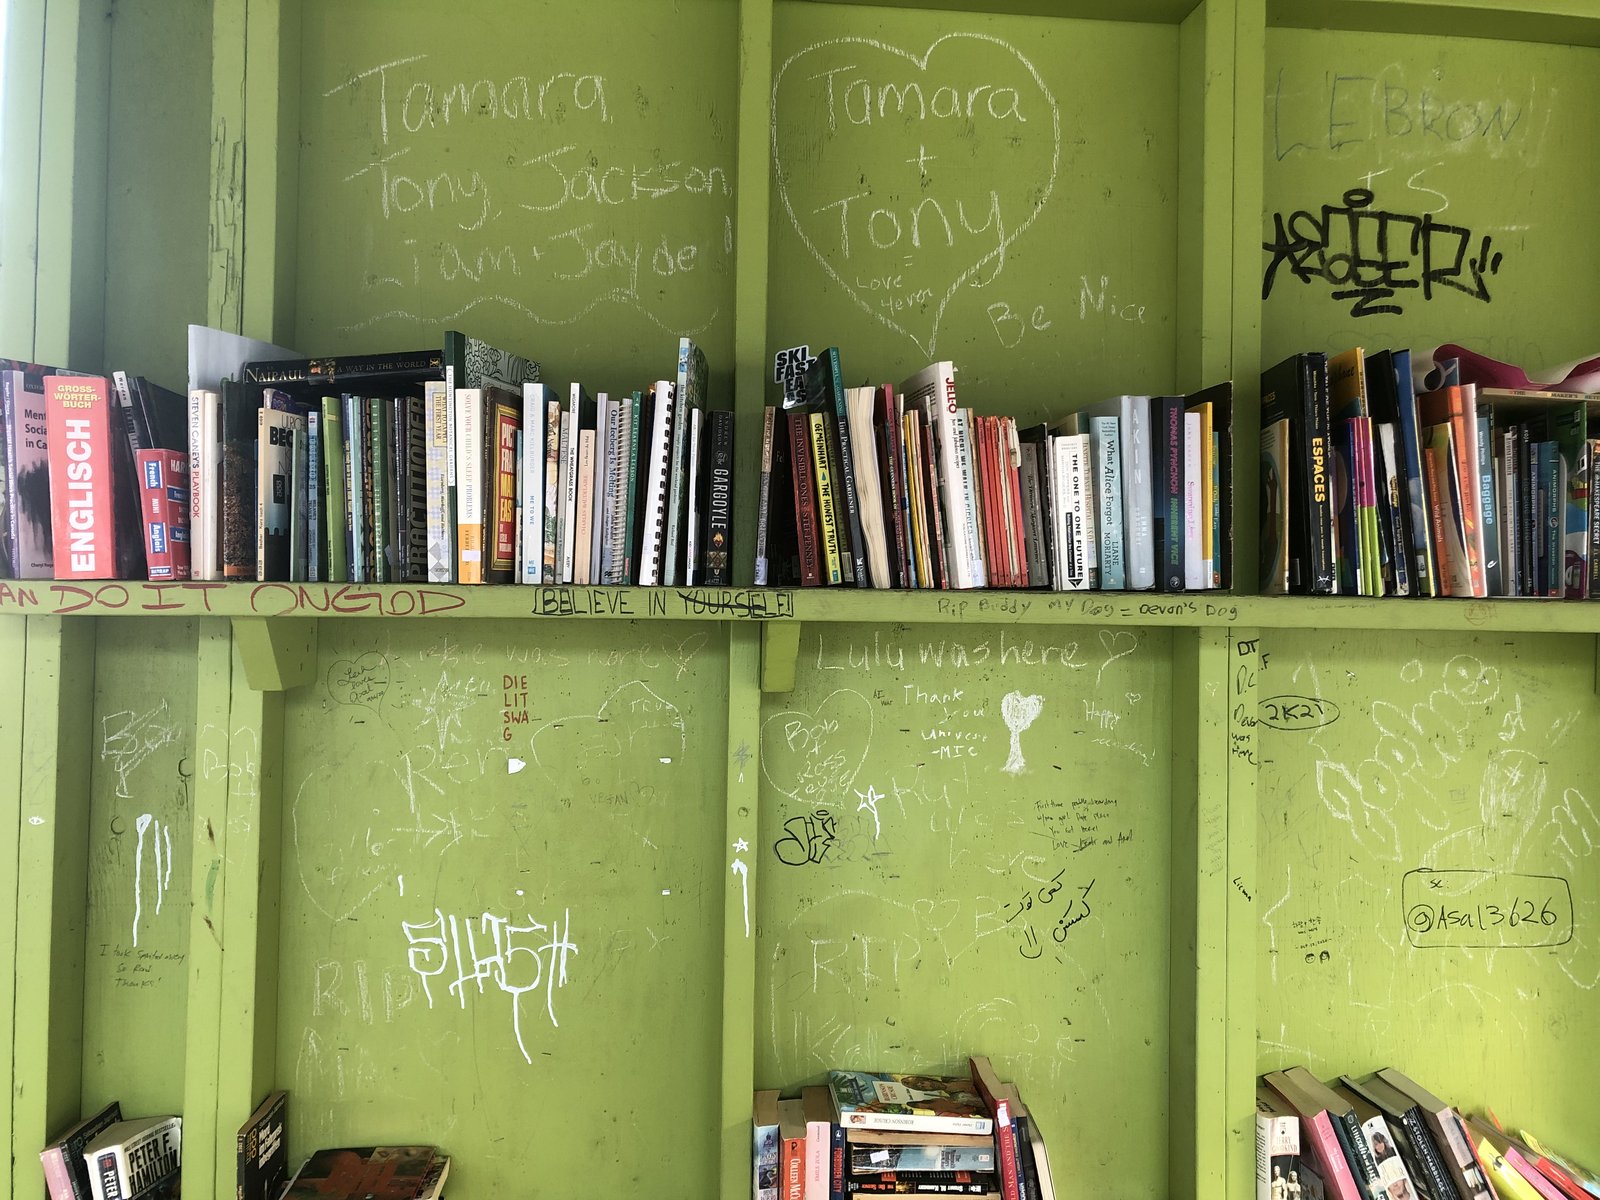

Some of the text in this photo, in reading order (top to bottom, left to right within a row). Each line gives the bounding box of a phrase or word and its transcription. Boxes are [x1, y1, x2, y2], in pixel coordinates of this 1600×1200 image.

[807, 65, 1027, 135] Tamara
[812, 190, 1006, 288] Tony
[987, 275, 1146, 349] Be Nice
[377, 362, 394, 370] THE
[396, 360, 427, 369] WORLD
[777, 346, 807, 367] SKI
[57, 385, 96, 393] GROSS-
[245, 367, 306, 384] NAIPAUL
[54, 391, 102, 401] WÖRTER-
[63, 400, 92, 409] BUCH
[25, 439, 34, 449] in
[191, 396, 200, 518] STEVEN CANEY'S PLAYBOOK
[560, 427, 568, 464] MALTESE
[606, 409, 617, 498] Our Iceberg Is Melting
[814, 423, 828, 470] GEMEINHART
[957, 418, 966, 467] AT WE
[1132, 408, 1141, 484] AKIN
[795, 437, 805, 481] INVISIBLE
[839, 420, 855, 514] THE PRACTICAL GARDENER
[1312, 437, 1325, 502] ESPACES
[1592, 461, 1600, 472] THE
[148, 462, 158, 488] French
[822, 482, 831, 497] THE
[1103, 440, 1116, 526] What Alice Forgot
[1169, 407, 1178, 566] THOMAS PYNCHON INHERENT VICE
[65, 419, 96, 572] ENGLISCH
[711, 468, 729, 530] GARGOYLE
[799, 482, 808, 506] ONES
[1074, 500, 1080, 513] TO
[1481, 475, 1493, 525] Baggage
[529, 495, 535, 525] ME TO WE
[802, 511, 811, 533] STEF
[823, 498, 833, 527] HONEST
[152, 524, 163, 552] Anglais
[826, 526, 836, 555] TRUTH
[1435, 519, 1443, 543] Animals
[1592, 521, 1600, 544] SECRET
[804, 534, 814, 569] PENNEY
[1111, 541, 1119, 566] LIANE
[50, 584, 130, 613] DO
[141, 583, 227, 613] IT
[649, 591, 666, 616] IN
[979, 598, 1031, 614] Buddy
[1205, 603, 1238, 620] Dog
[918, 630, 1088, 669] was here
[503, 675, 527, 690] DIE
[903, 684, 964, 705] Thank
[504, 692, 528, 707] LIT
[503, 710, 529, 724] SWA
[503, 727, 512, 741] G
[129, 1138, 160, 1173] PETER
[162, 1132, 173, 1153] F.
[1003, 1135, 1011, 1148] THE
[129, 1150, 178, 1196] HAMILTON
[790, 1158, 801, 1183] COLLEEN
[833, 1147, 843, 1193] FORBIDDEN CITY
[1411, 1126, 1448, 1193] STOLEN MARRIAGE
[104, 1170, 118, 1199] PETER
